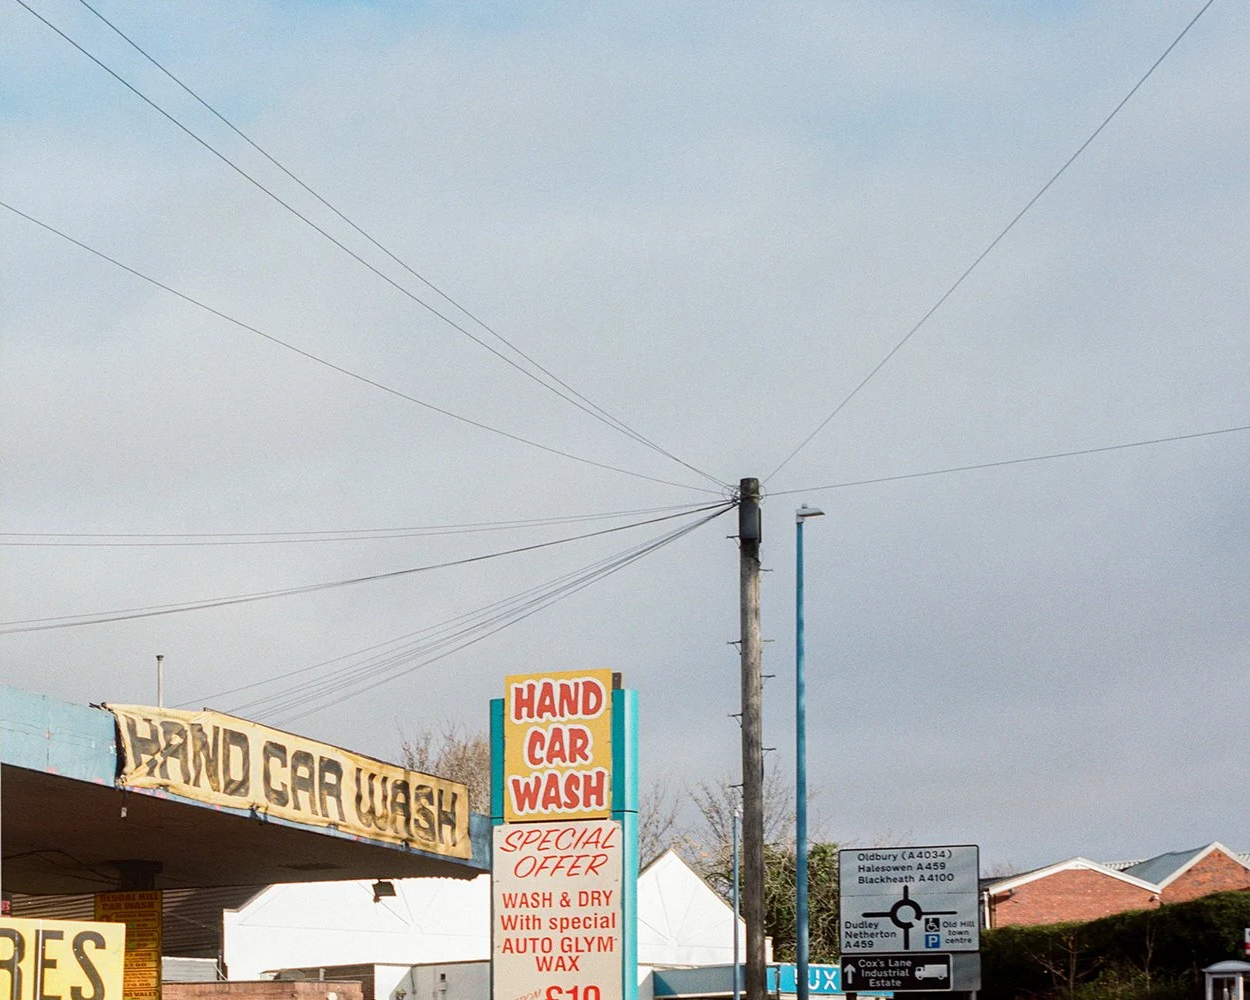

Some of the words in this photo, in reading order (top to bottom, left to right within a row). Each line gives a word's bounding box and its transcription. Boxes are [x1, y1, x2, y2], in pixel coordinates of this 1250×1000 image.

[514, 680, 603, 720] HAND
[527, 727, 590, 766] CAR
[126, 717, 250, 797] HAND
[263, 740, 346, 821] CAR
[355, 767, 458, 847] WASH
[512, 770, 605, 812] WASH
[500, 827, 615, 853] SPECIAL
[857, 852, 898, 862] Oldbury
[901, 849, 952, 861] (A4034)
[513, 853, 609, 878] OFFER
[858, 864, 913, 873] Halesowen
[916, 862, 946, 871] A459
[858, 874, 915, 884] Blackheath
[918, 873, 954, 882] A4100
[125, 902, 154, 910] WASH
[502, 892, 553, 909] WASH
[559, 891, 571, 908] &
[578, 890, 613, 907] DRY
[500, 914, 542, 931] With
[549, 912, 616, 933] special
[844, 920, 879, 930] Dudley
[942, 920, 957, 928] Old
[960, 920, 975, 928] Hill
[844, 930, 897, 939] Netherton
[928, 935, 938, 947] P
[502, 937, 553, 954] AUTO
[560, 936, 614, 953] GLYM
[844, 940, 874, 949] A459
[535, 955, 580, 972] WAX
[858, 959, 885, 968] Cox's
[888, 959, 912, 967] Lane
[794, 968, 837, 990] UX
[861, 969, 909, 977] Industrial
[869, 979, 901, 987] Estate
